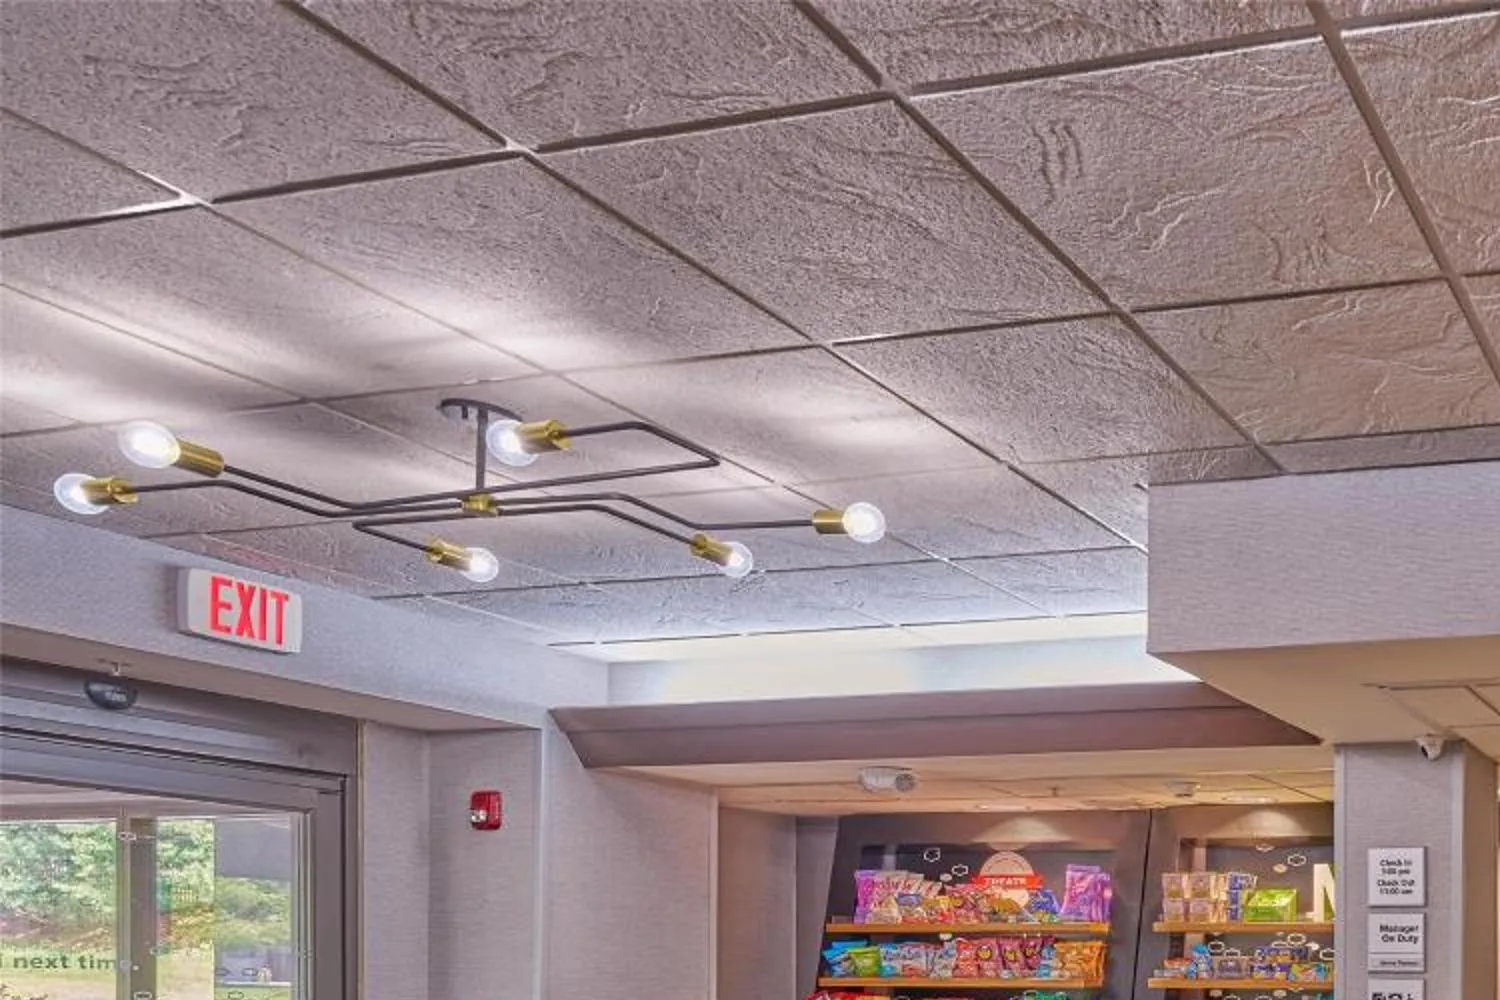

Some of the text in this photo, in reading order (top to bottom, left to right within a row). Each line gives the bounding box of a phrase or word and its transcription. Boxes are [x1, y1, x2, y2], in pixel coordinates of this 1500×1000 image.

[209, 574, 290, 646] EXIT
[1397, 933, 1418, 945] Duty
[13, 953, 71, 969] next
